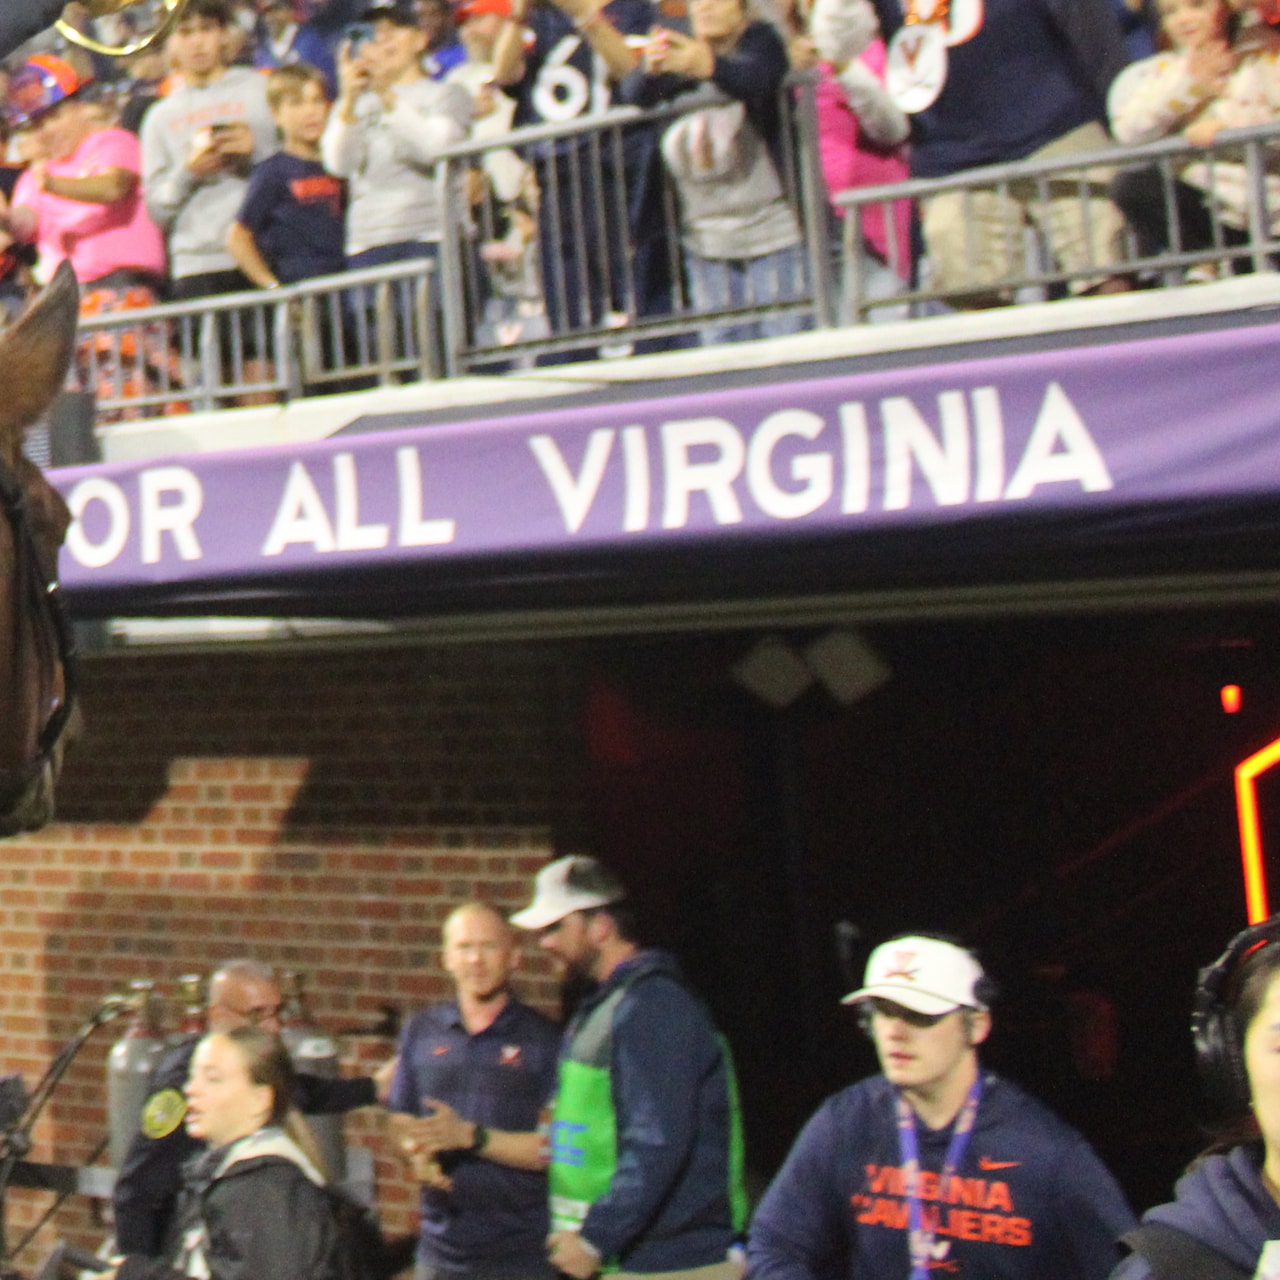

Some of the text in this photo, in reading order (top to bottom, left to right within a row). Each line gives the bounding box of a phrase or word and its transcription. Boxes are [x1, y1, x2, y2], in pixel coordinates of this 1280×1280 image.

[260, 446, 456, 557] ALL
[528, 381, 1114, 534] VIRGINIA
[851, 1193, 1033, 1247] CAVLIERS
